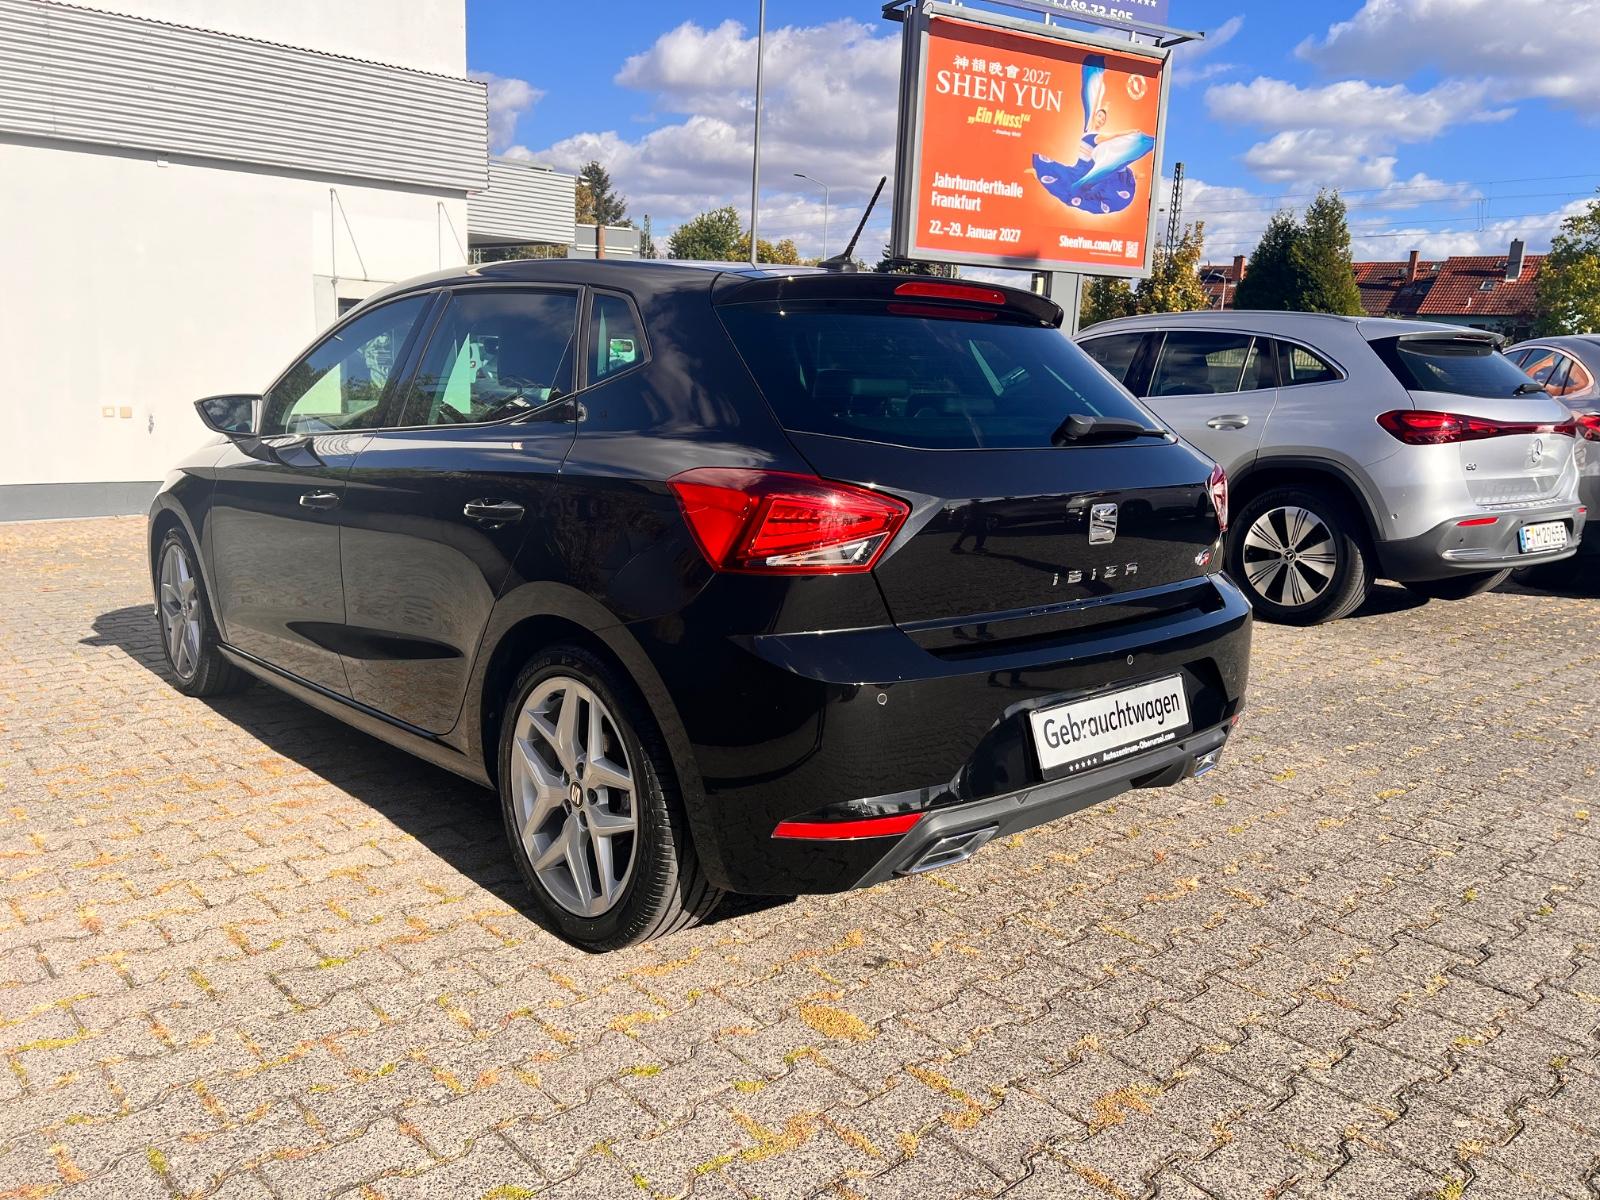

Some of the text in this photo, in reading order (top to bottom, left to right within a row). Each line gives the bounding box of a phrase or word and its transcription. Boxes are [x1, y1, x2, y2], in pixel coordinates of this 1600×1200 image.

[1022, 67, 1051, 85] 2027
[935, 70, 1063, 112] SHEN YUN
[932, 171, 1023, 198] Jahrhunderthalle
[931, 190, 981, 212] Frankfurt
[965, 224, 998, 240] Januar
[998, 227, 1021, 243] 2027
[1059, 235, 1123, 253] ShenYun.com/DE
[1052, 562, 1139, 586] IBIZA
[1043, 692, 1180, 749] Gebrauchtwagen
[1103, 732, 1175, 761] Autozentrum-Oberursel.com
